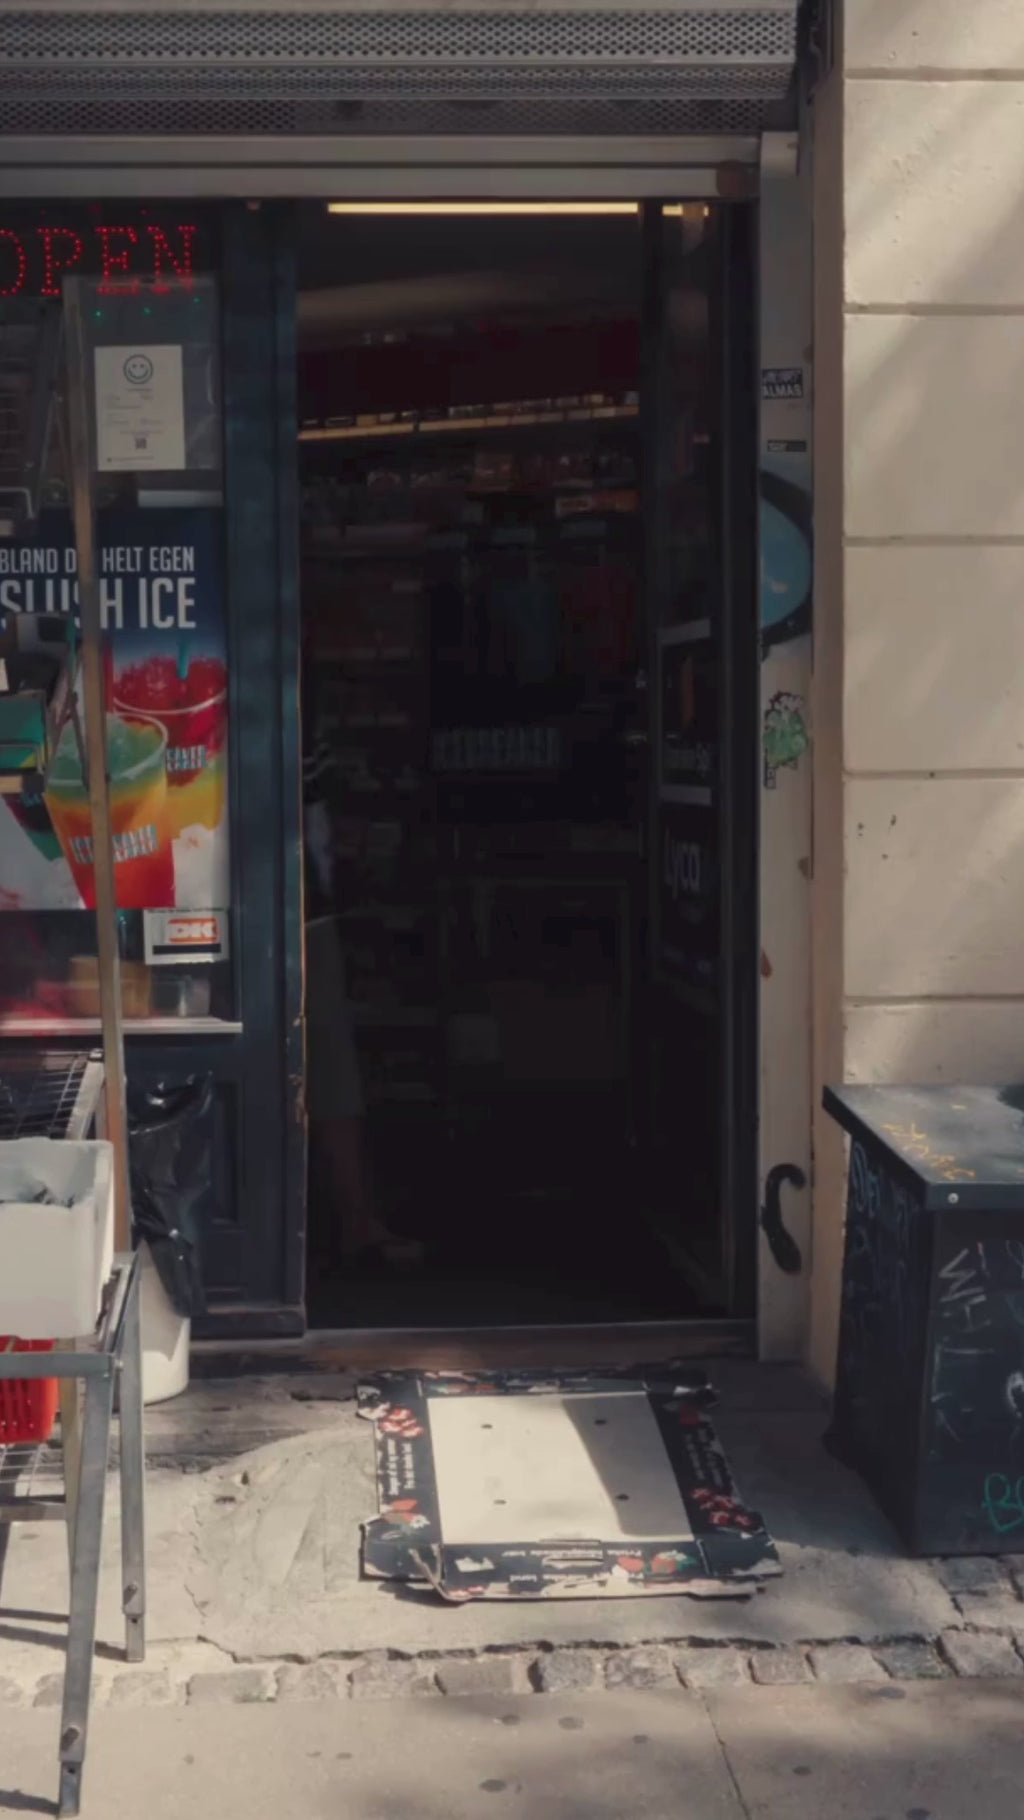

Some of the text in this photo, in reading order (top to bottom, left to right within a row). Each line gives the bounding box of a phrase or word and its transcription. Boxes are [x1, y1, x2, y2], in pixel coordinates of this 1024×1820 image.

[0, 224, 198, 297] OPEN
[0, 548, 58, 574] BLAND
[102, 546, 143, 573] HELT
[150, 546, 195, 573] EGEN
[0, 576, 197, 630] SLUH ICE
